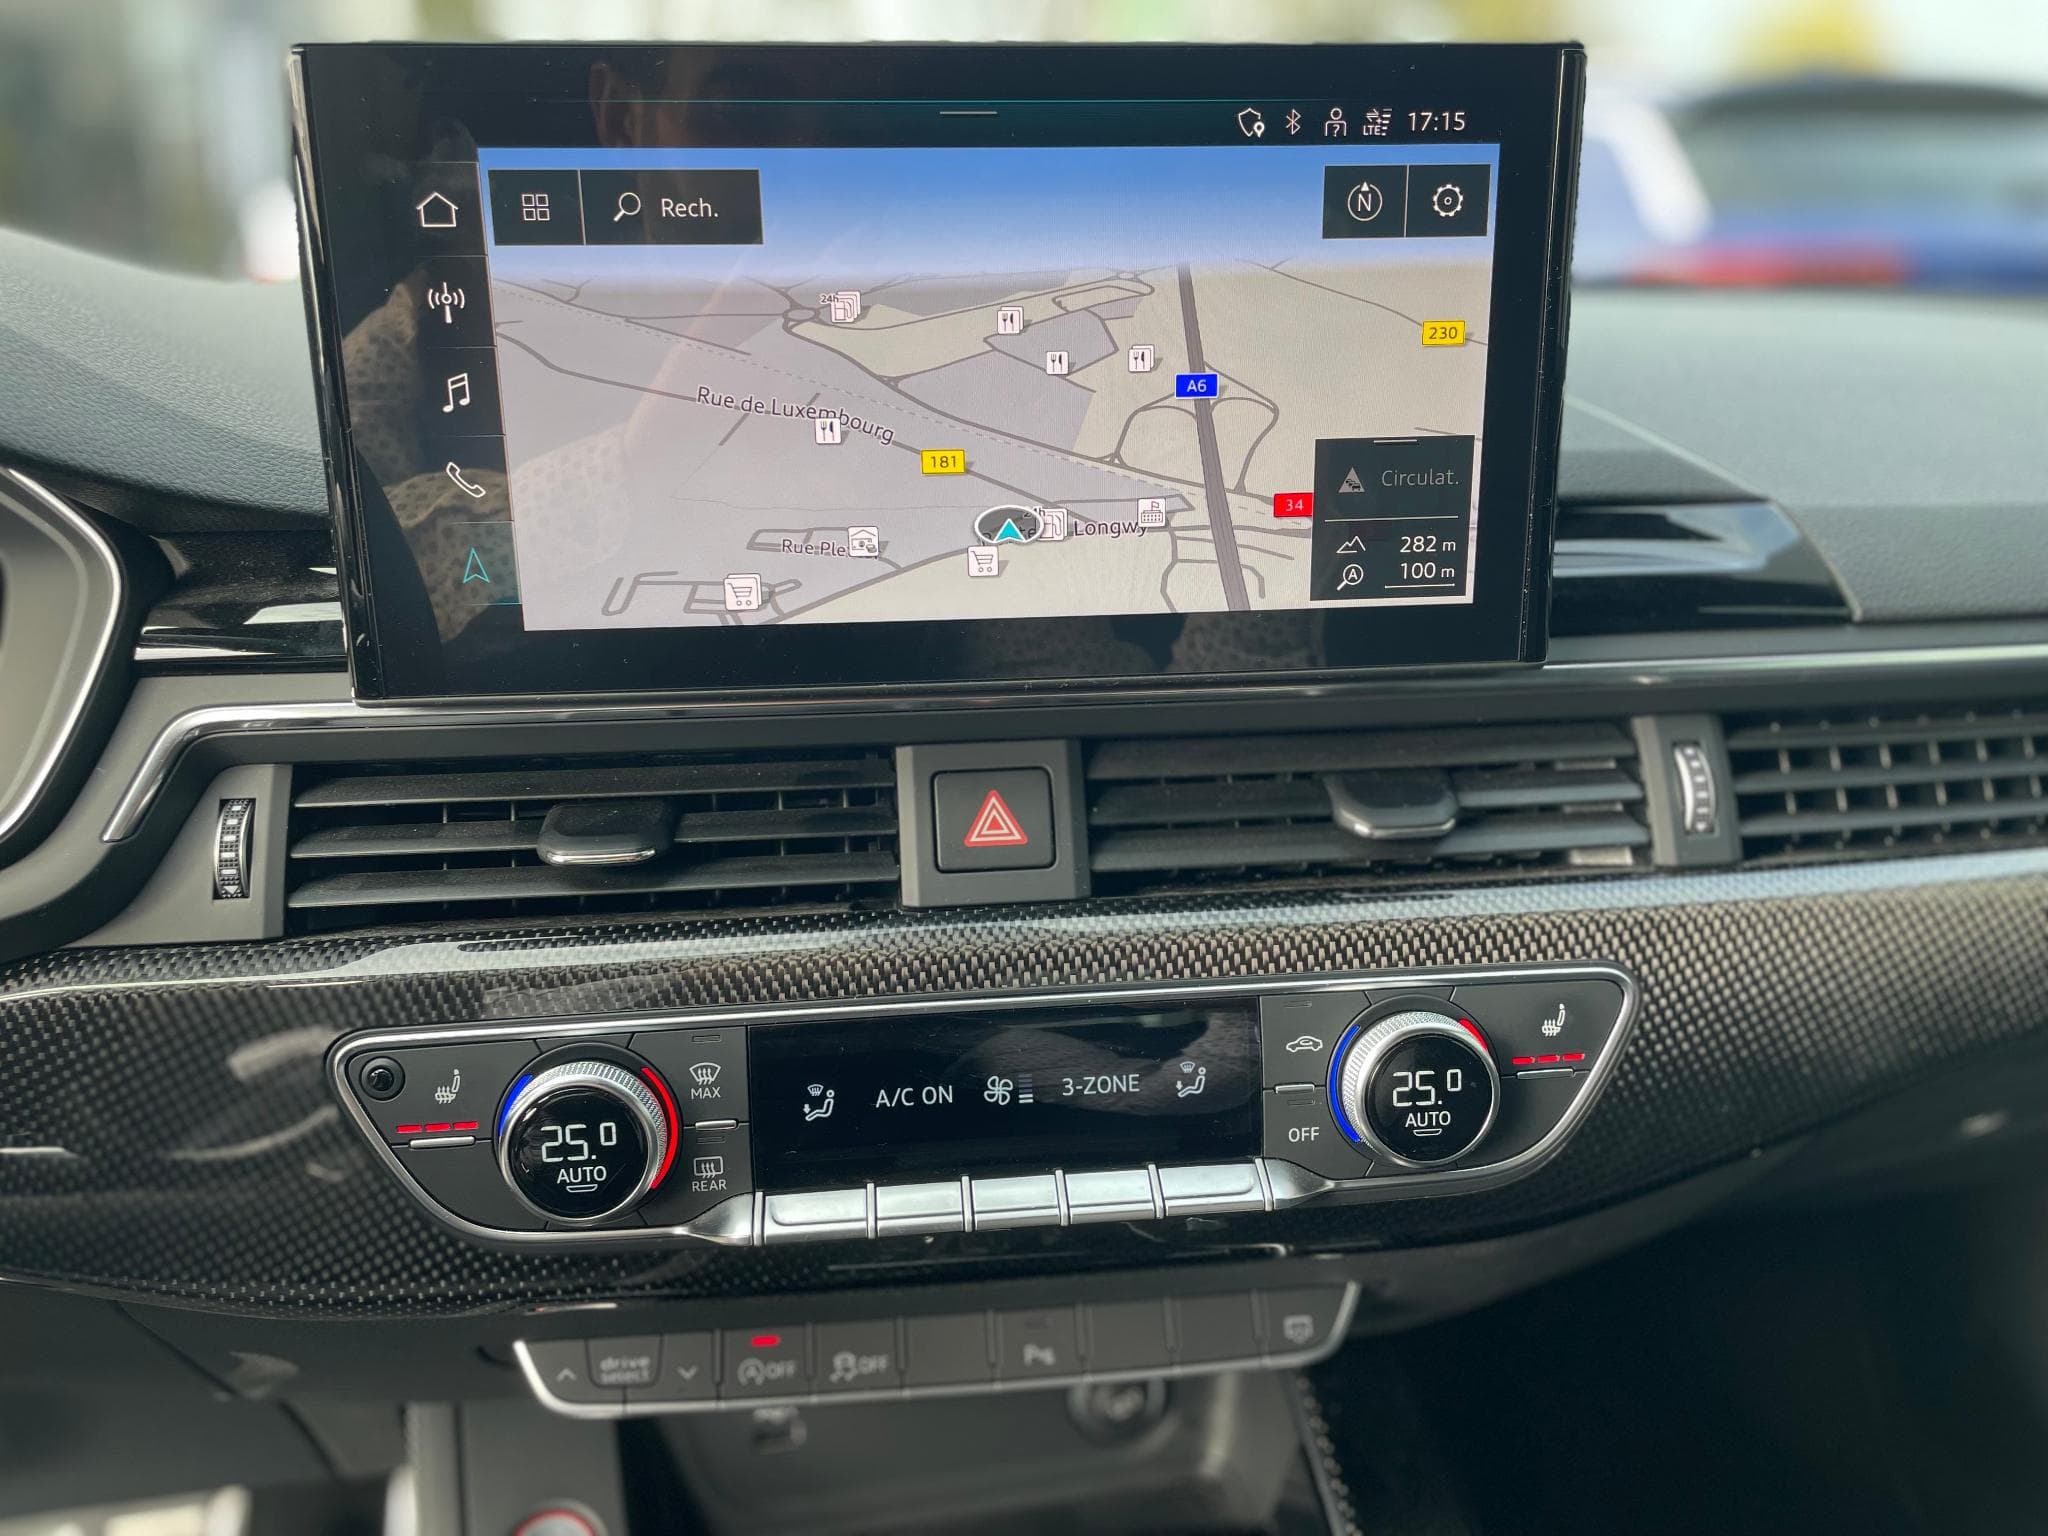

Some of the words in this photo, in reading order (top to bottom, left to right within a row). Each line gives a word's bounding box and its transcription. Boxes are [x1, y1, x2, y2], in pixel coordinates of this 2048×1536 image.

[1363, 125, 1381, 136] LTE
[1407, 111, 1466, 132] 17:15
[661, 198, 719, 218] Rech.
[1357, 192, 1372, 212] N
[1429, 326, 1458, 340] 230
[1187, 379, 1207, 393] A6
[697, 386, 735, 409] Rue
[740, 395, 765, 415] de
[772, 398, 894, 444] Luxembourg
[930, 455, 957, 468] 181
[1381, 468, 1459, 487] Circulat.
[1285, 498, 1305, 512] 34
[1074, 520, 1148, 539] Longwy
[782, 538, 815, 555] Rue
[1400, 535, 1437, 553] 282
[1442, 541, 1457, 551] m
[1400, 562, 1436, 580] 100
[1441, 567, 1456, 578] m
[690, 1086, 722, 1100] MAX
[1061, 1073, 1141, 1097] 3-ZONE
[875, 1087, 914, 1109] A/C
[921, 1085, 954, 1105] ON
[1404, 1110, 1452, 1128] AUTO
[1288, 1126, 1320, 1142] OFF
[556, 1166, 608, 1184] AUTO
[691, 1179, 727, 1192] REAR
[600, 1356, 651, 1371] drive
[764, 1361, 797, 1380] OFF
[857, 1354, 890, 1376] OFF
